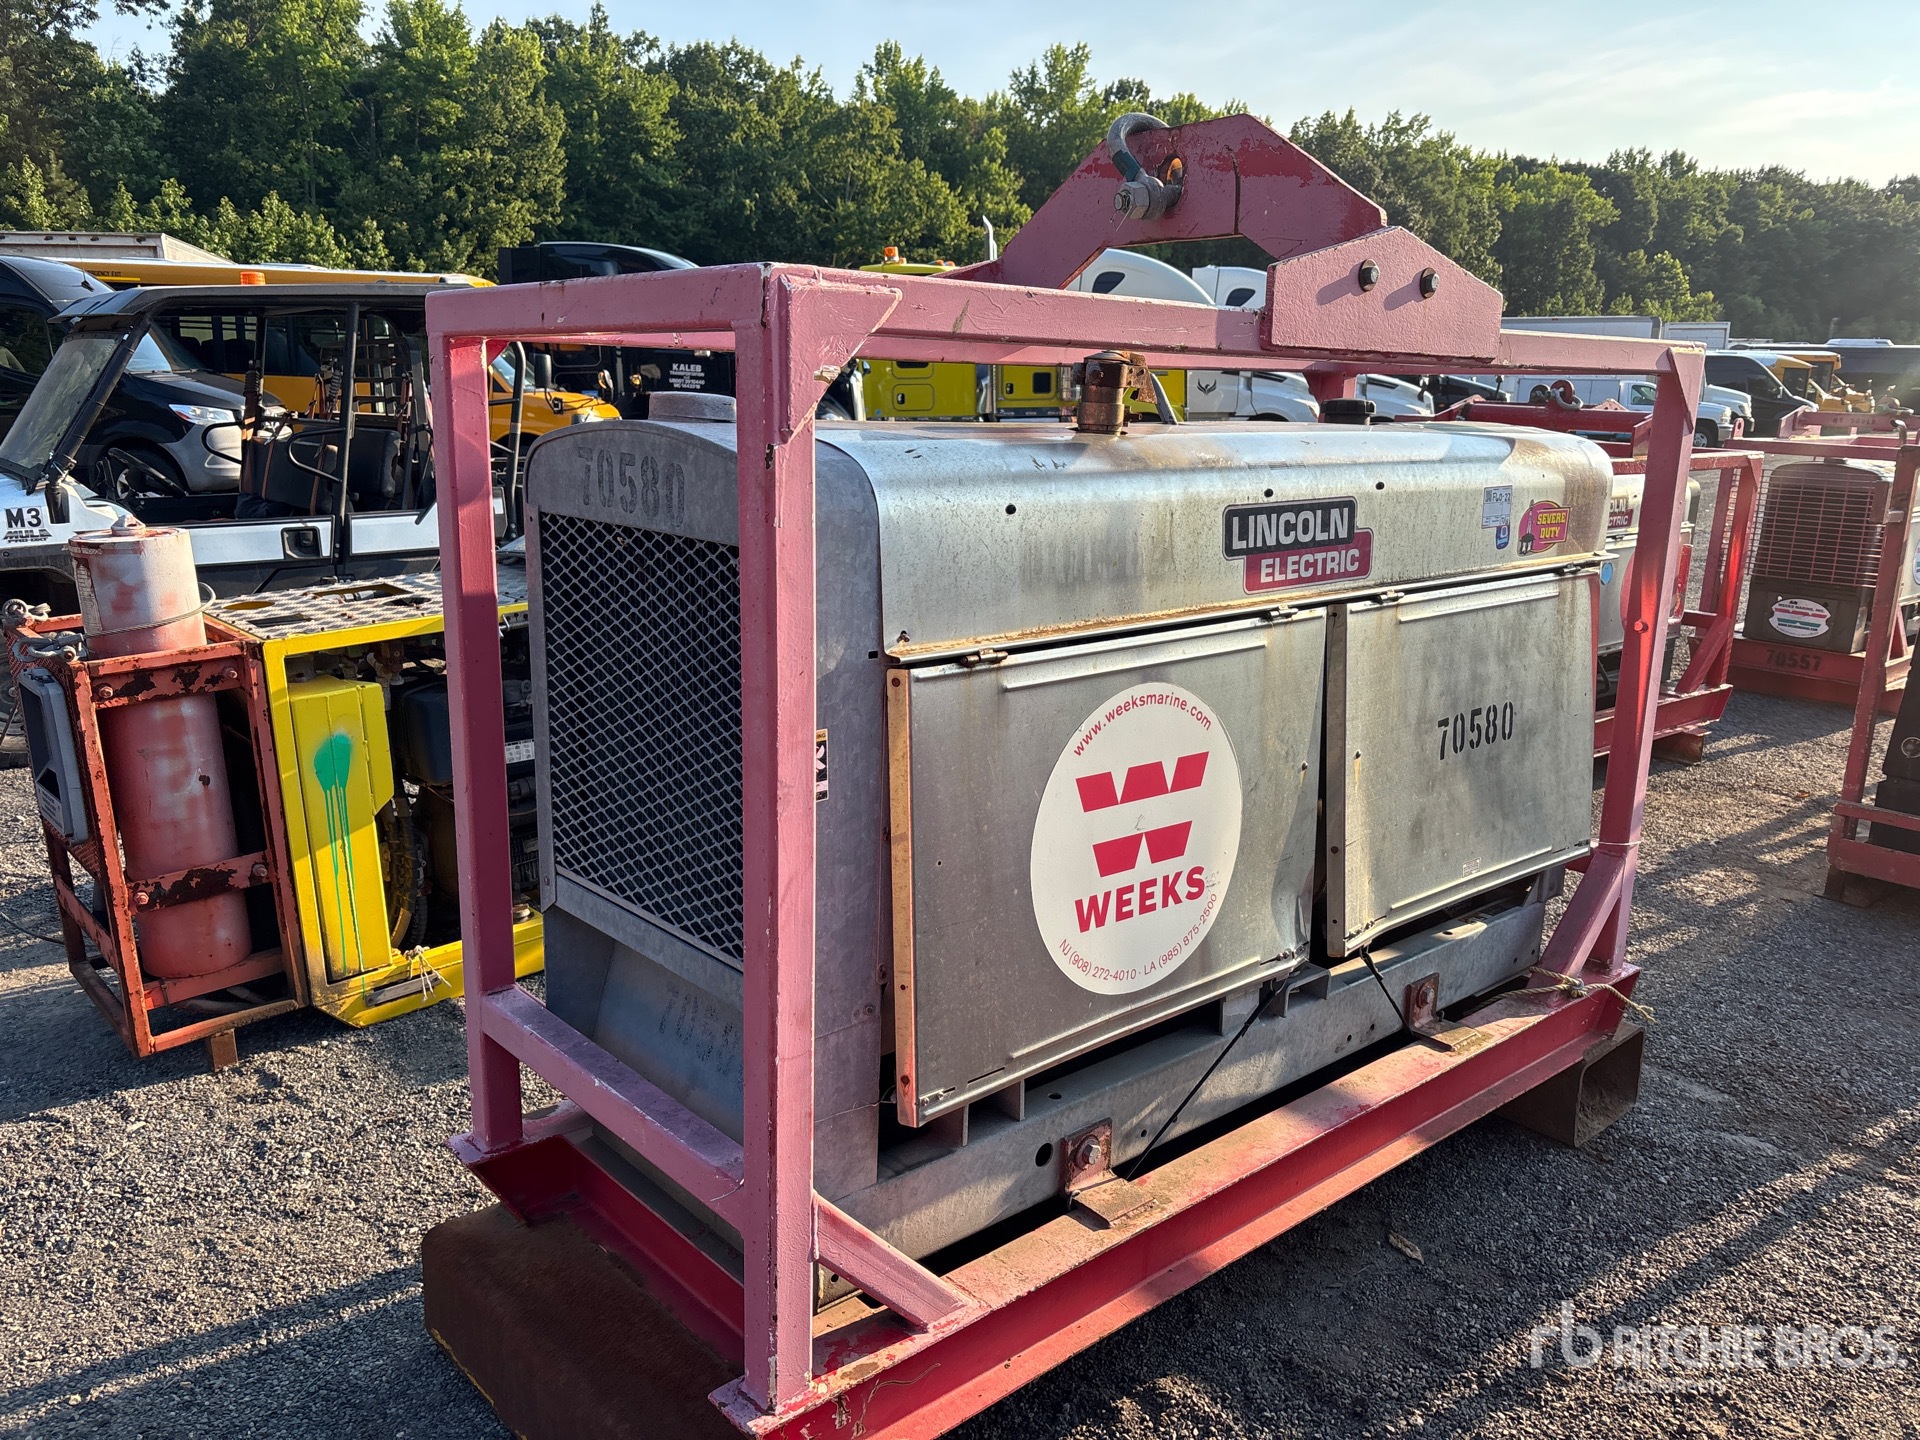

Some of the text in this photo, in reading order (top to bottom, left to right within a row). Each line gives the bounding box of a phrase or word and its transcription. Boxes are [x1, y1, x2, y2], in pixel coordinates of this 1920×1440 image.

[672, 363, 702, 372] KALEB
[578, 446, 685, 528] 70580
[5, 507, 42, 528] M3
[1232, 507, 1349, 550] LINCOLN
[1537, 512, 1567, 525] SEVERE
[1539, 526, 1561, 539] DUTY
[1608, 515, 1629, 527] CTRIC
[1260, 548, 1360, 584] ELECTRIC
[1766, 649, 1822, 671] 70557
[1073, 692, 1212, 757] www.weeksmarine.com
[1437, 701, 1514, 760] 70580
[1074, 865, 1206, 934] WEEKS
[1058, 892, 1218, 982] NJ (908) 272-4010 LA (985) 875-2500
